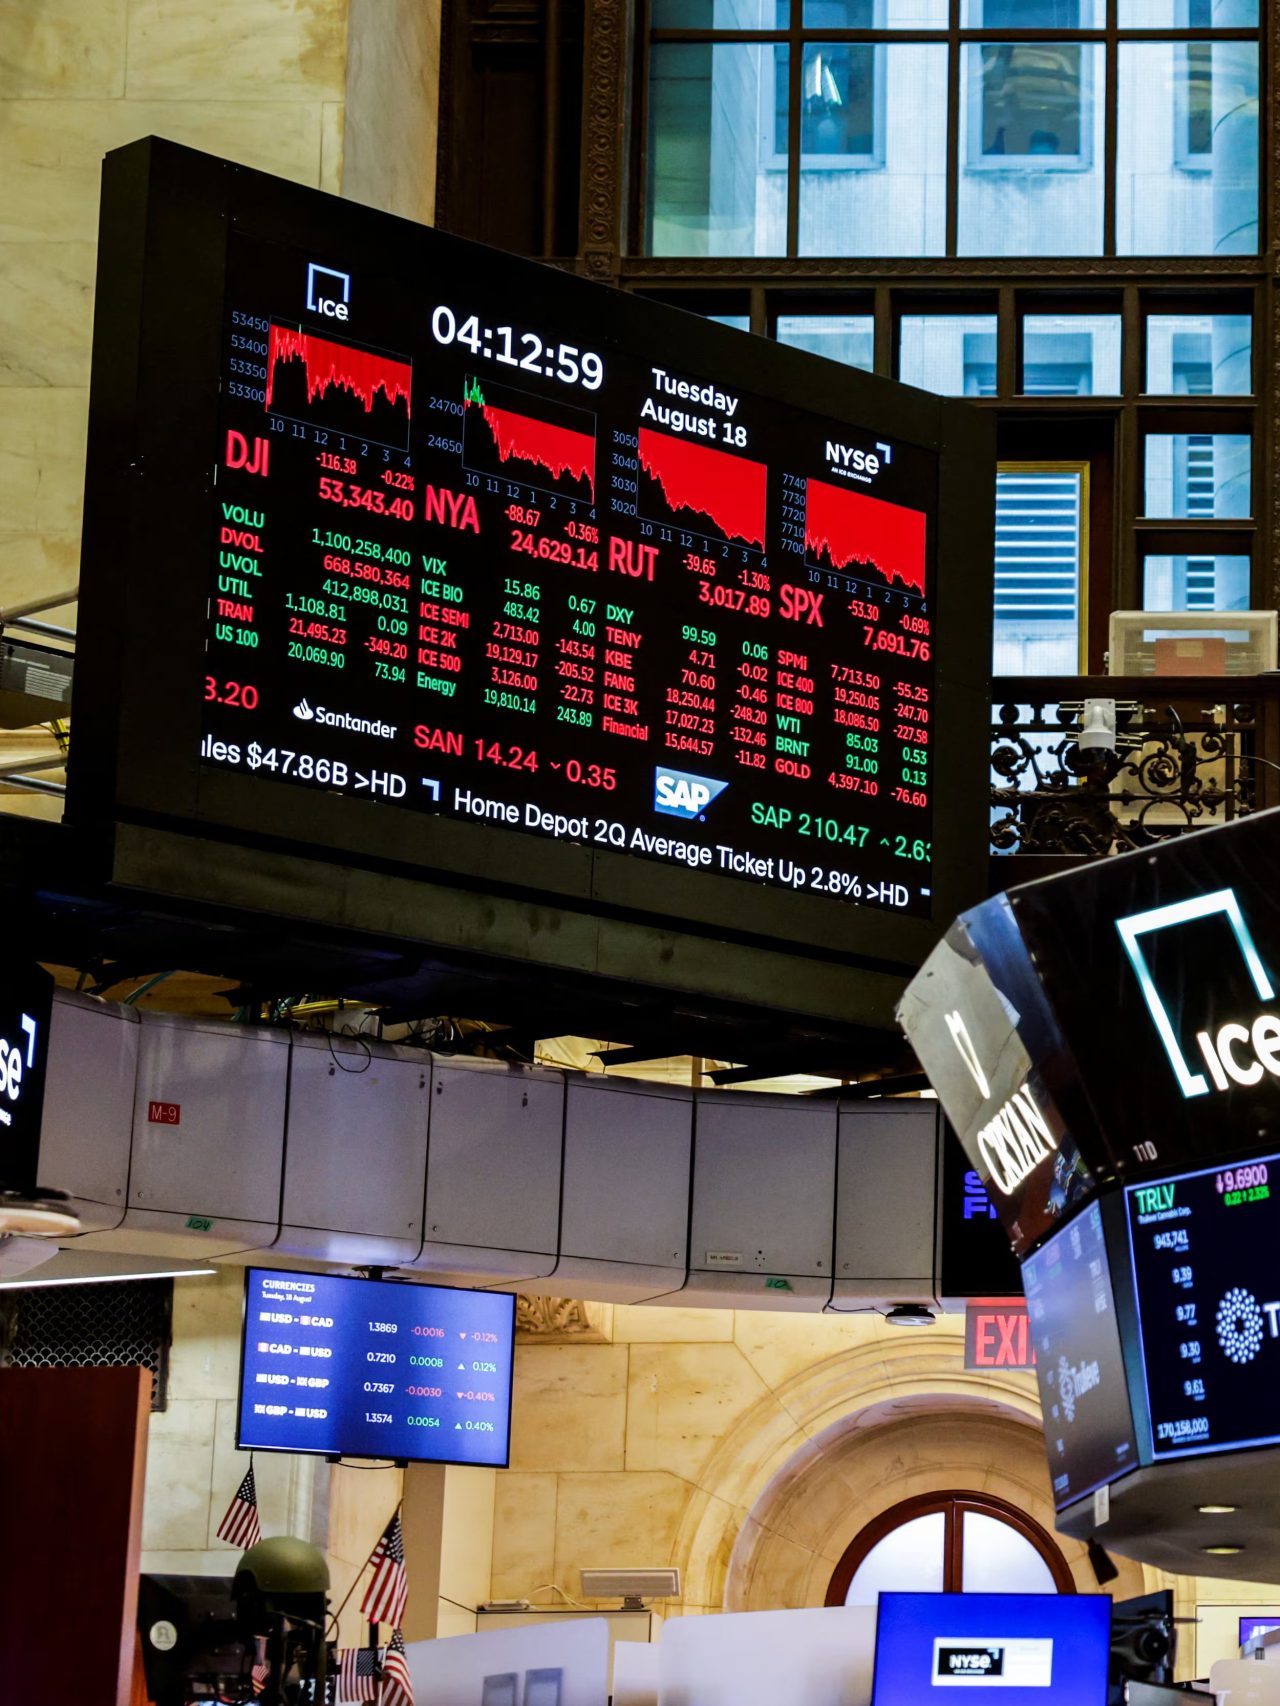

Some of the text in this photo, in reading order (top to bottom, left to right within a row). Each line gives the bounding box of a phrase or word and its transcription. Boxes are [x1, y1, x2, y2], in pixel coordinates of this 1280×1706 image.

[432, 305, 603, 390] 04:12:59
[652, 367, 738, 416] Tuesday
[640, 397, 747, 447] August 18
[226, 429, 269, 477] DJI
[316, 452, 414, 491] -116.38 -0.22%
[319, 477, 414, 521] 53,343.40
[425, 484, 480, 534] NYA
[222, 502, 410, 566] VOLU 1,100,258,400
[504, 504, 599, 544] -88.67 -0.36%
[221, 526, 410, 590] DVOL 668,580,364
[511, 529, 599, 572] 24,629.14
[609, 536, 659, 581] RUT
[220, 551, 408, 613] UVOL 412,898,031
[422, 555, 540, 600] VIX 15.86
[682, 553, 771, 592] -39.65 -1.30%
[218, 574, 407, 636] UTIL 1,108.81 0.09
[421, 578, 539, 623] ICE BIO 483.42
[699, 580, 770, 618] 3,017.89
[779, 583, 824, 628] SPX
[848, 599, 930, 636] -53.30 -0.69%
[217, 598, 407, 659] TRAN 21,495.23 -349.20
[419, 602, 539, 646] ICE SEMI 2,713.00
[607, 604, 716, 646] DXY 99.59
[863, 625, 930, 661] 7,691.76
[215, 622, 405, 683] US 100 20,069.90 73.94
[418, 625, 538, 668] ICE 2K 19,129.17
[605, 626, 715, 669] TENY 4.71
[417, 648, 537, 691] ICE 500 3,126.00
[605, 649, 715, 690] KBE 70.60
[776, 671, 880, 711] ICE 400 19,250.05
[831, 664, 880, 690] 7,713.50
[417, 671, 536, 714] Energy 19,810.14
[604, 671, 715, 712] FANG 18,250.44
[776, 692, 880, 732] ICE 800 18,086.50
[315, 705, 398, 740] Santander
[603, 693, 714, 734] ICE 3K 17,027.23
[776, 714, 878, 753] WTI 85.03
[414, 724, 463, 756] SAN
[475, 739, 538, 773] 14.24
[602, 715, 714, 756] Financial 15,644.57
[776, 735, 878, 774] BRNT 91.00
[246, 741, 348, 786] $47.86B
[774, 758, 878, 796] GOLD 4,397.10
[655, 776, 712, 813] SAP
[454, 787, 519, 823] Home
[525, 803, 588, 839] Depot
[593, 819, 626, 849] 2Q
[629, 826, 712, 868] Average
[716, 845, 774, 879] Ticket
[779, 859, 805, 888] Up
[810, 866, 862, 897] 2.8%
[751, 802, 791, 829] SAP
[798, 813, 869, 847] 210.47
[151, 1104, 177, 1122] M-9
[1135, 1184, 1175, 1214] TRLV
[262, 1279, 316, 1293] CURRENCIES
[311, 1317, 334, 1328] CAD
[368, 1322, 398, 1334] 1.3869
[410, 1326, 445, 1338] -0.0016
[975, 1315, 1037, 1366] EXI
[269, 1344, 292, 1355] CAD
[366, 1352, 396, 1364] 0.7210
[409, 1356, 444, 1368] 0.0008
[363, 1382, 395, 1394] 0.7367
[365, 1412, 393, 1424] 1.3574
[407, 1416, 440, 1428] 0.0054
